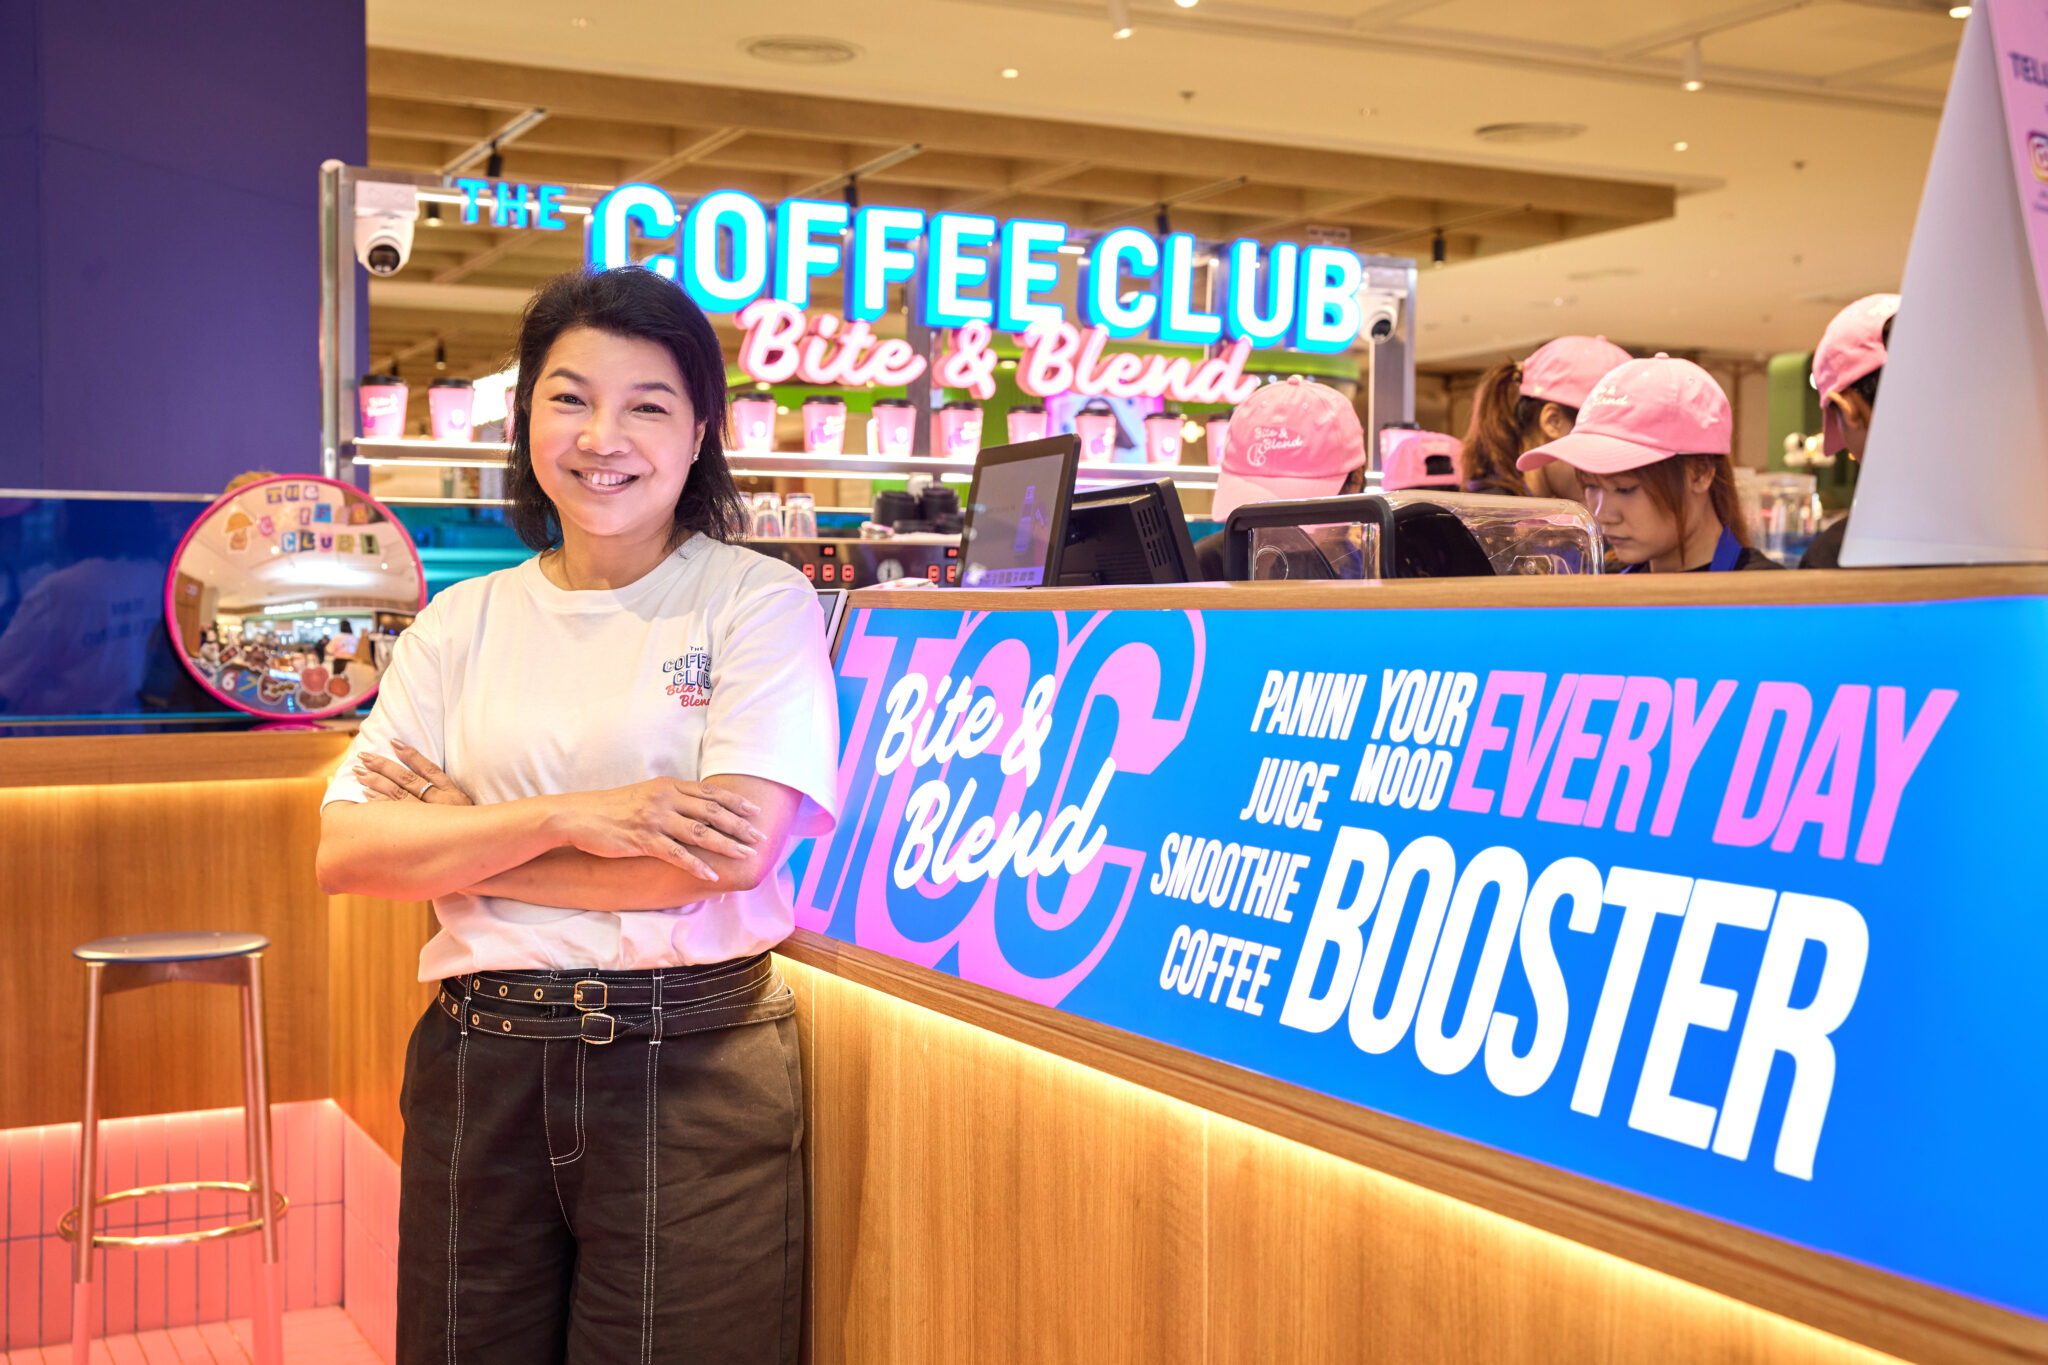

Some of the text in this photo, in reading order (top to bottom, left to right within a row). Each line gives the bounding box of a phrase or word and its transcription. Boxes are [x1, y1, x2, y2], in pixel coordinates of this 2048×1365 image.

[457, 177, 567, 231] THE
[587, 182, 1363, 354] COFFEE CLUB
[733, 298, 1260, 405] Bite & Blend
[1263, 435, 1303, 450] Blend
[665, 684, 696, 696] Bite
[672, 670, 712, 690] CLUB
[1250, 669, 1479, 747] PANINI YOUR
[876, 673, 1055, 788] Bite &
[1448, 670, 1959, 865] EVERY DAY
[1239, 757, 1340, 832] JUICE
[1350, 744, 1454, 811] MOOD
[894, 757, 1116, 890] Blend
[1150, 832, 1311, 923] SMOOTHIE
[1159, 924, 1281, 1016] COFFEE
[1279, 825, 1870, 1182] BOOSTER
